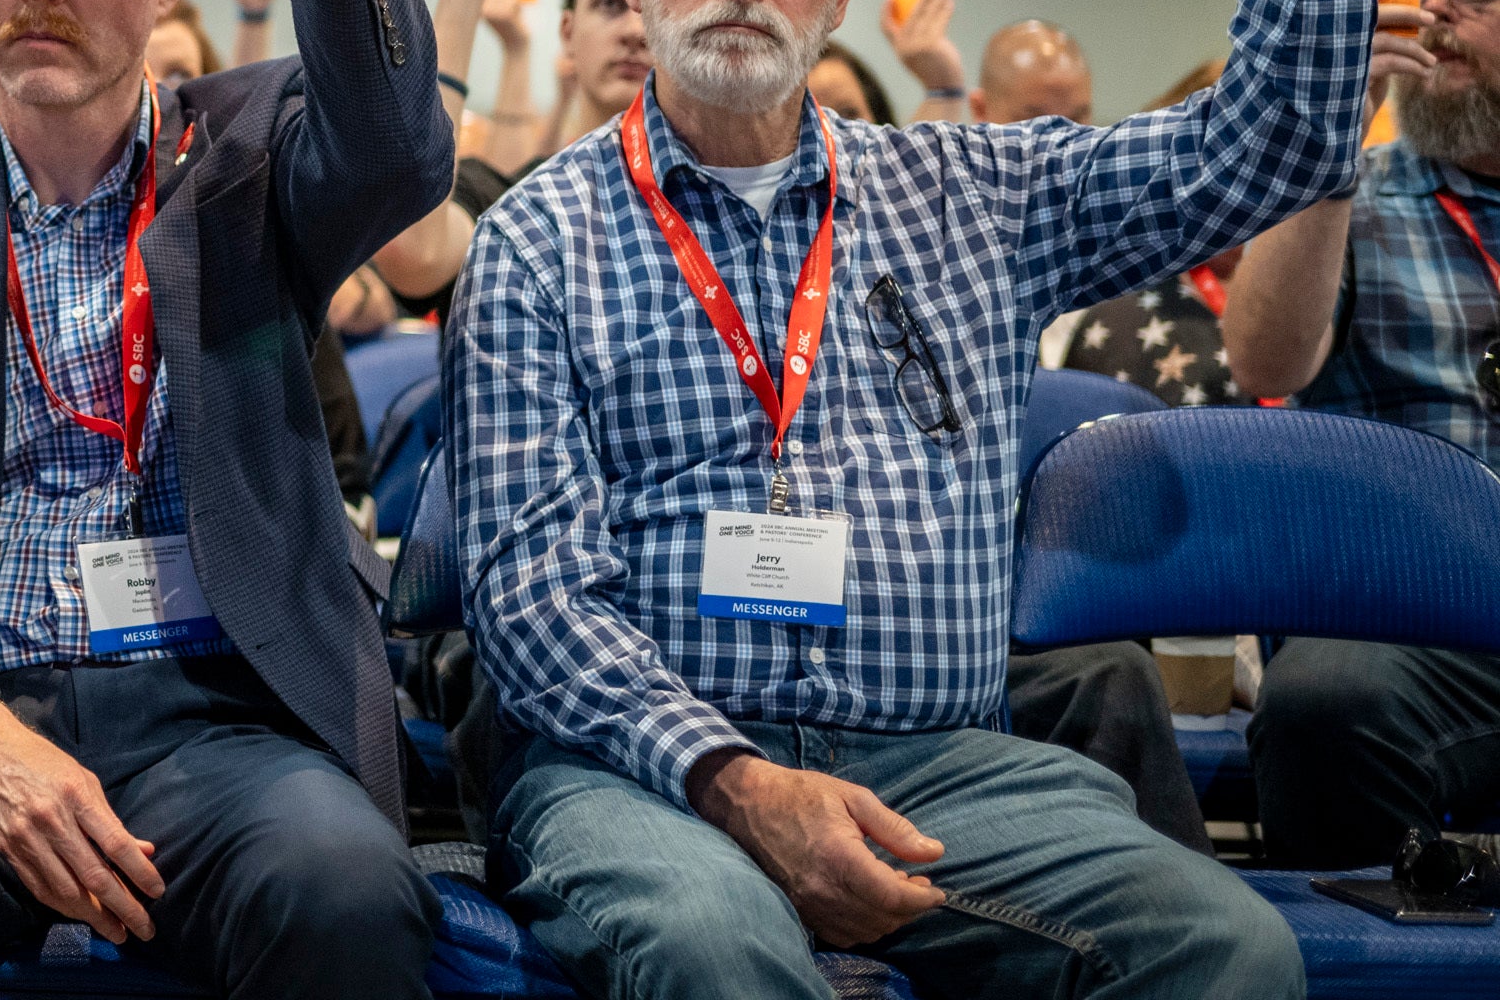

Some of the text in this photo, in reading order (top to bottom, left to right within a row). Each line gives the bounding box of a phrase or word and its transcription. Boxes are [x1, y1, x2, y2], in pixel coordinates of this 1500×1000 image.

[133, 333, 145, 361] SBC
[731, 328, 748, 356] SBC
[797, 330, 811, 355] SBC
[106, 557, 123, 565] VOICE
[756, 553, 781, 564] Jerry
[752, 564, 785, 572] Holderman
[127, 577, 156, 588] Robby
[732, 602, 808, 618] MESSENGER
[123, 625, 188, 643] MESSENGER
